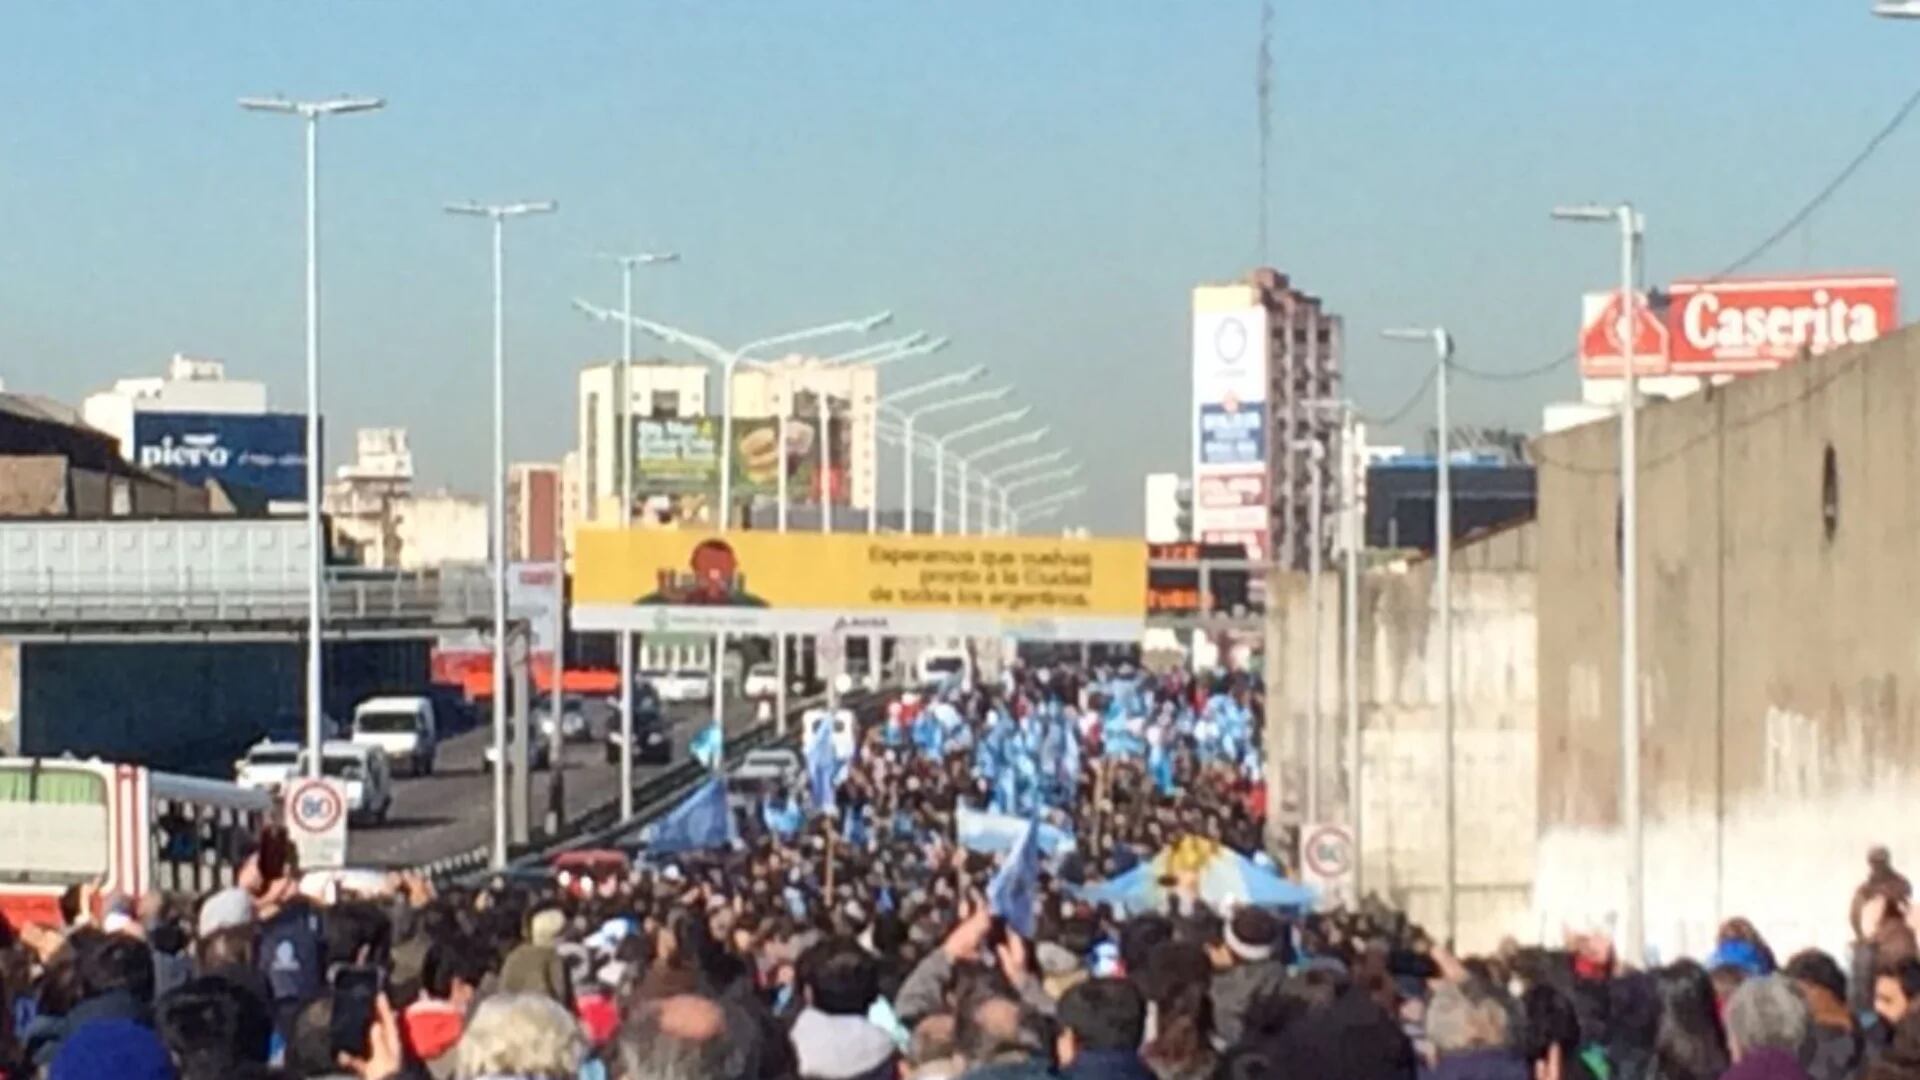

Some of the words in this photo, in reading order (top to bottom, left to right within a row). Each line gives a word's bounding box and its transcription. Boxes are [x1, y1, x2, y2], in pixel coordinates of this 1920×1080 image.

[1683, 289, 1879, 354] Caserita
[140, 434, 229, 468] piero
[868, 545, 975, 566] Esperamos
[980, 550, 1015, 567] que
[1020, 547, 1092, 565] vuelvas
[919, 569, 981, 587] pronto
[1024, 569, 1092, 586] Ciudad
[869, 585, 893, 602] de
[900, 586, 952, 603] todos
[957, 587, 983, 604] los
[301, 795, 333, 819] 80
